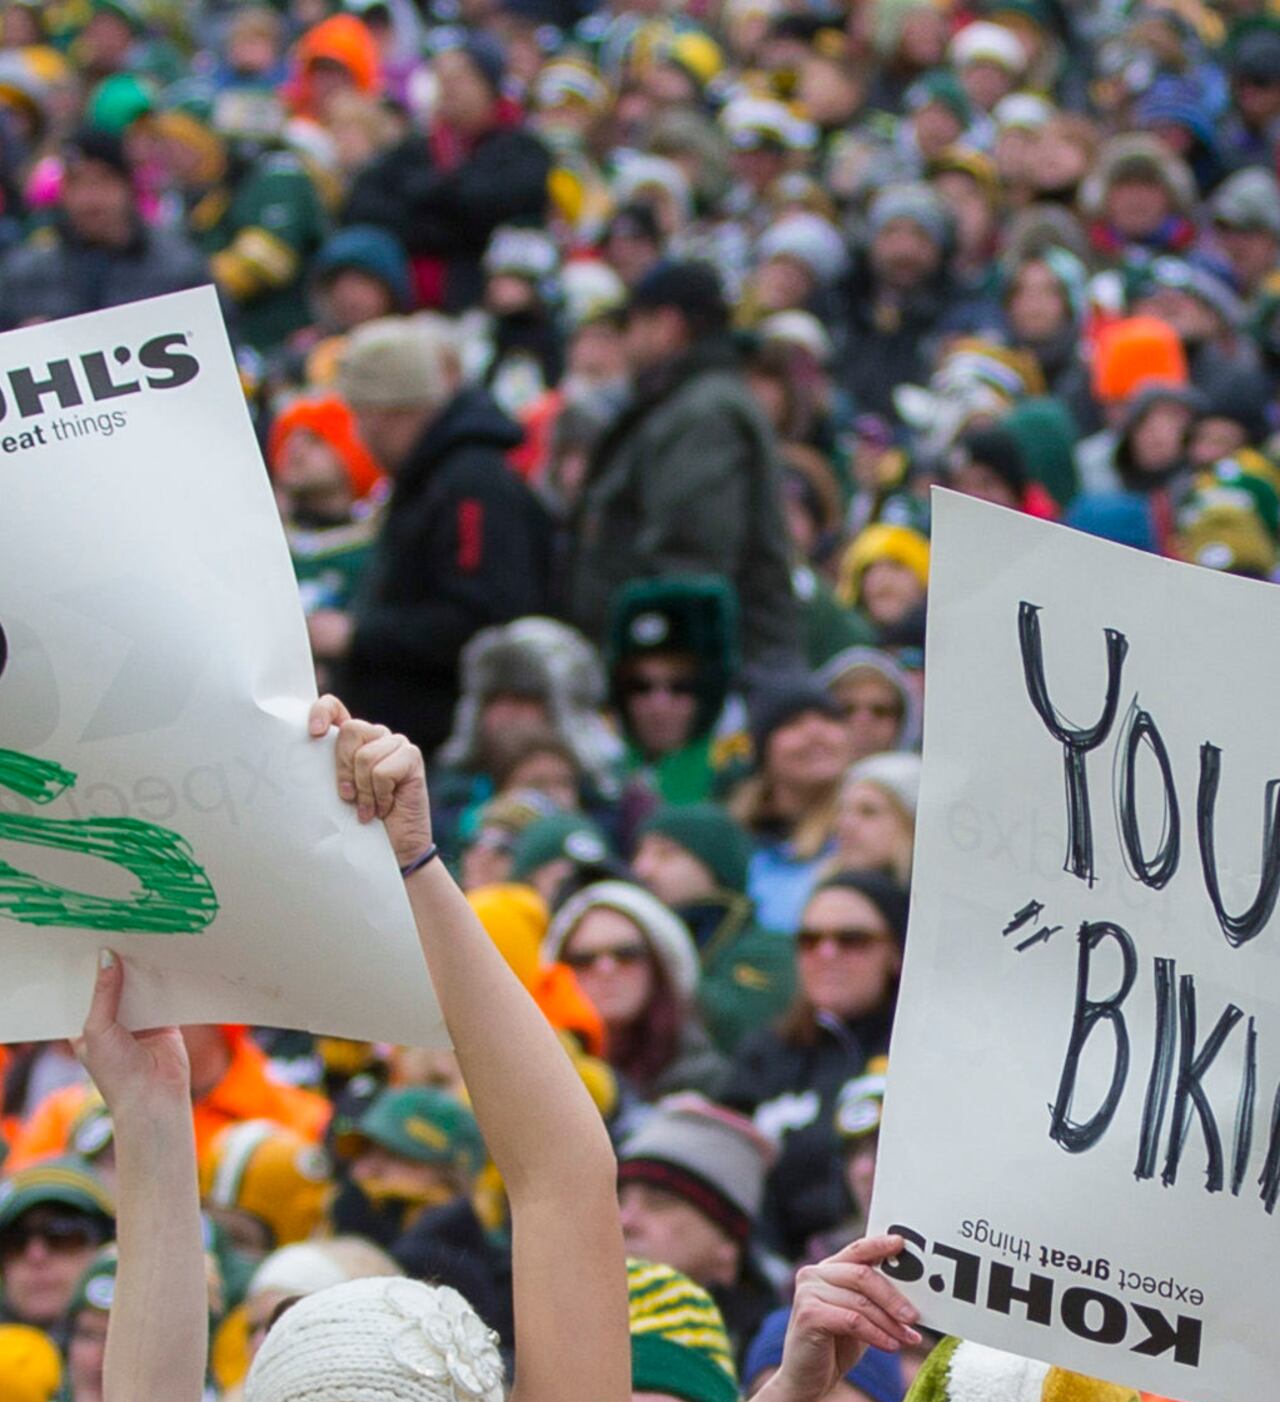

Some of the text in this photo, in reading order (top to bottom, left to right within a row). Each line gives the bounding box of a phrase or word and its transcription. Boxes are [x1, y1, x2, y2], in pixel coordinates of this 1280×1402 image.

[52, 409, 127, 442] things
[881, 1224, 1202, 1368] KOHL'S
[961, 1219, 1205, 1306] expect great things
